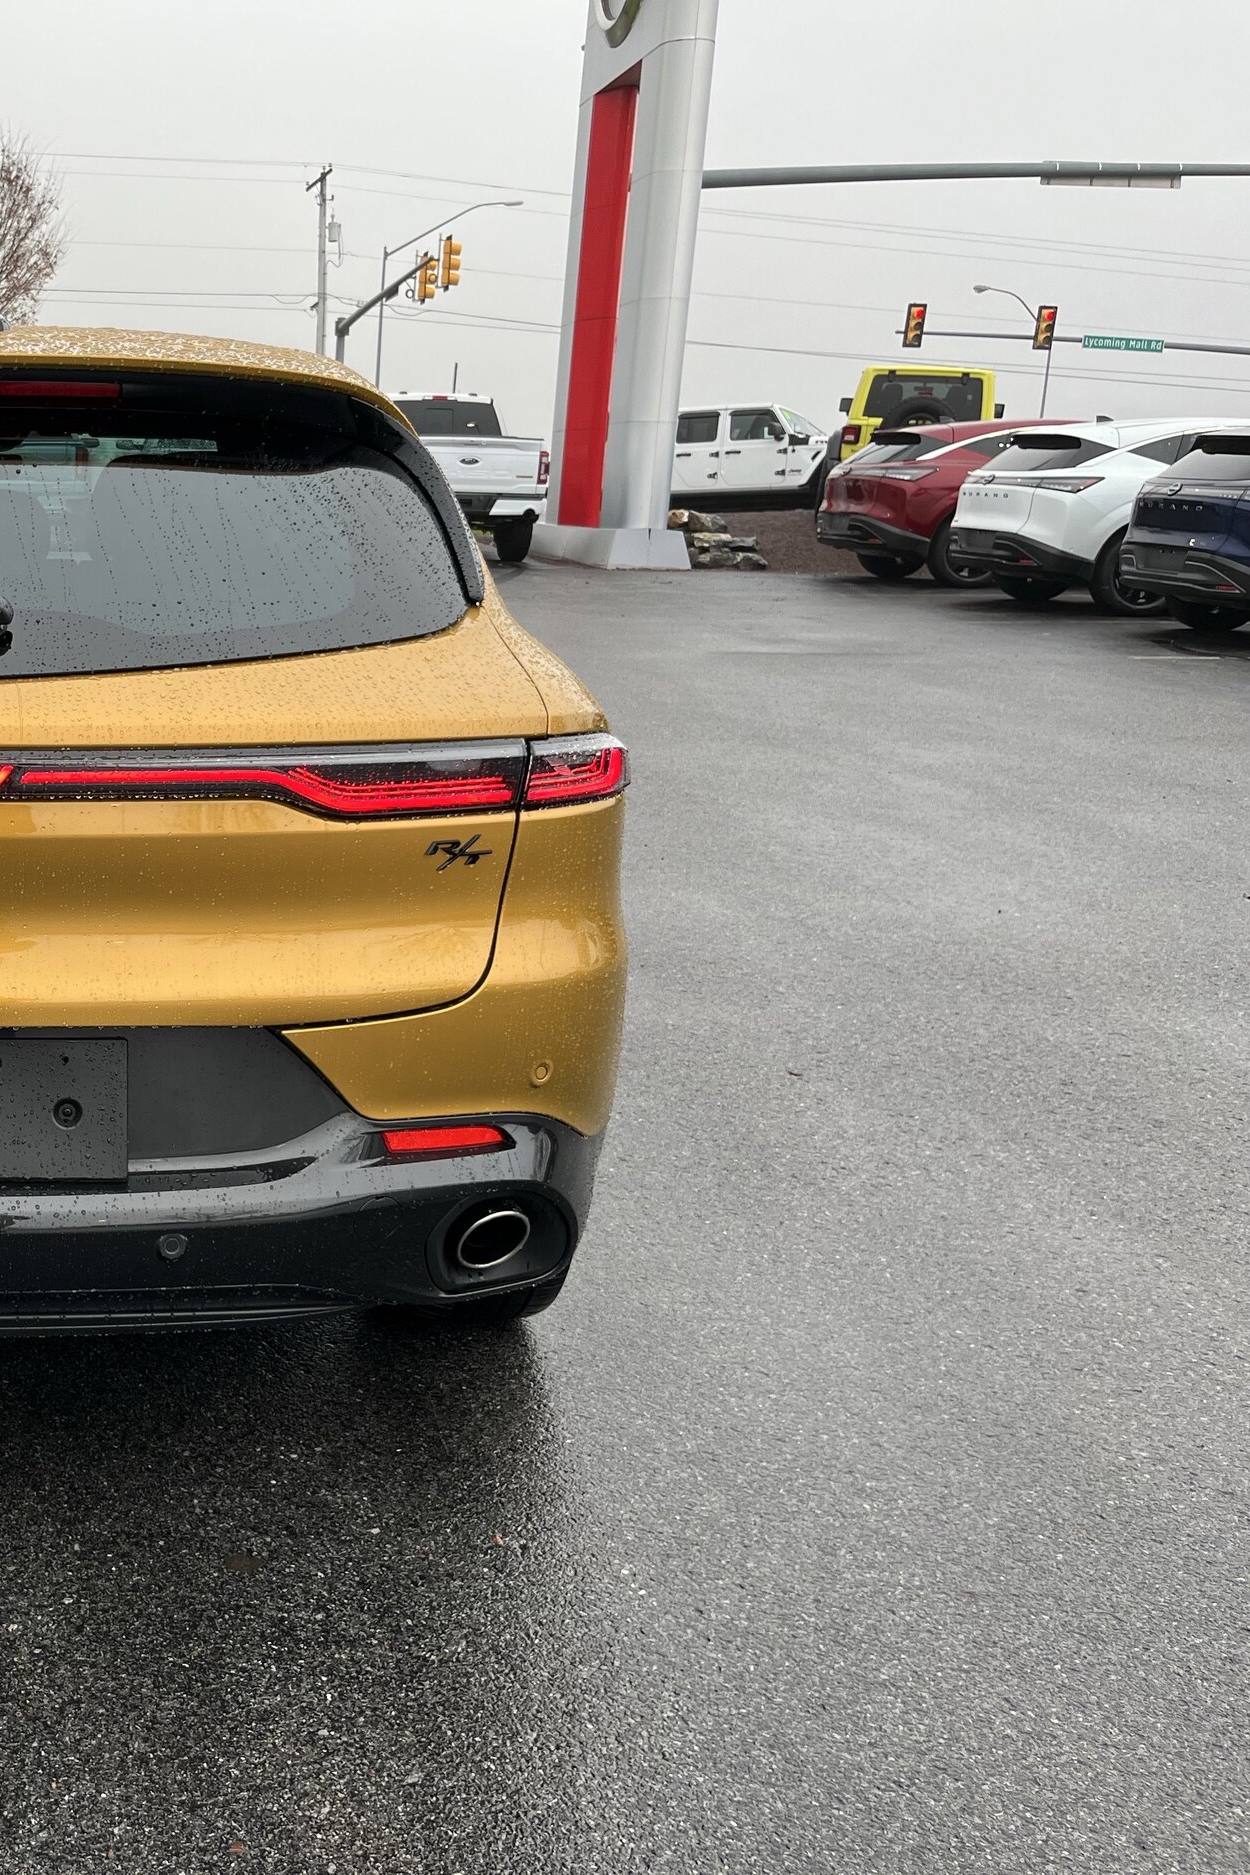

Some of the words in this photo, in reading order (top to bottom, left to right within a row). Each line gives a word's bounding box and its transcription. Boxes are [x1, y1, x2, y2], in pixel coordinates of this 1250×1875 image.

[1084, 336, 1126, 350] Lycoming
[1129, 339, 1148, 349] Mall
[1150, 341, 1162, 350] Rd
[423, 833, 493, 872] R/T
